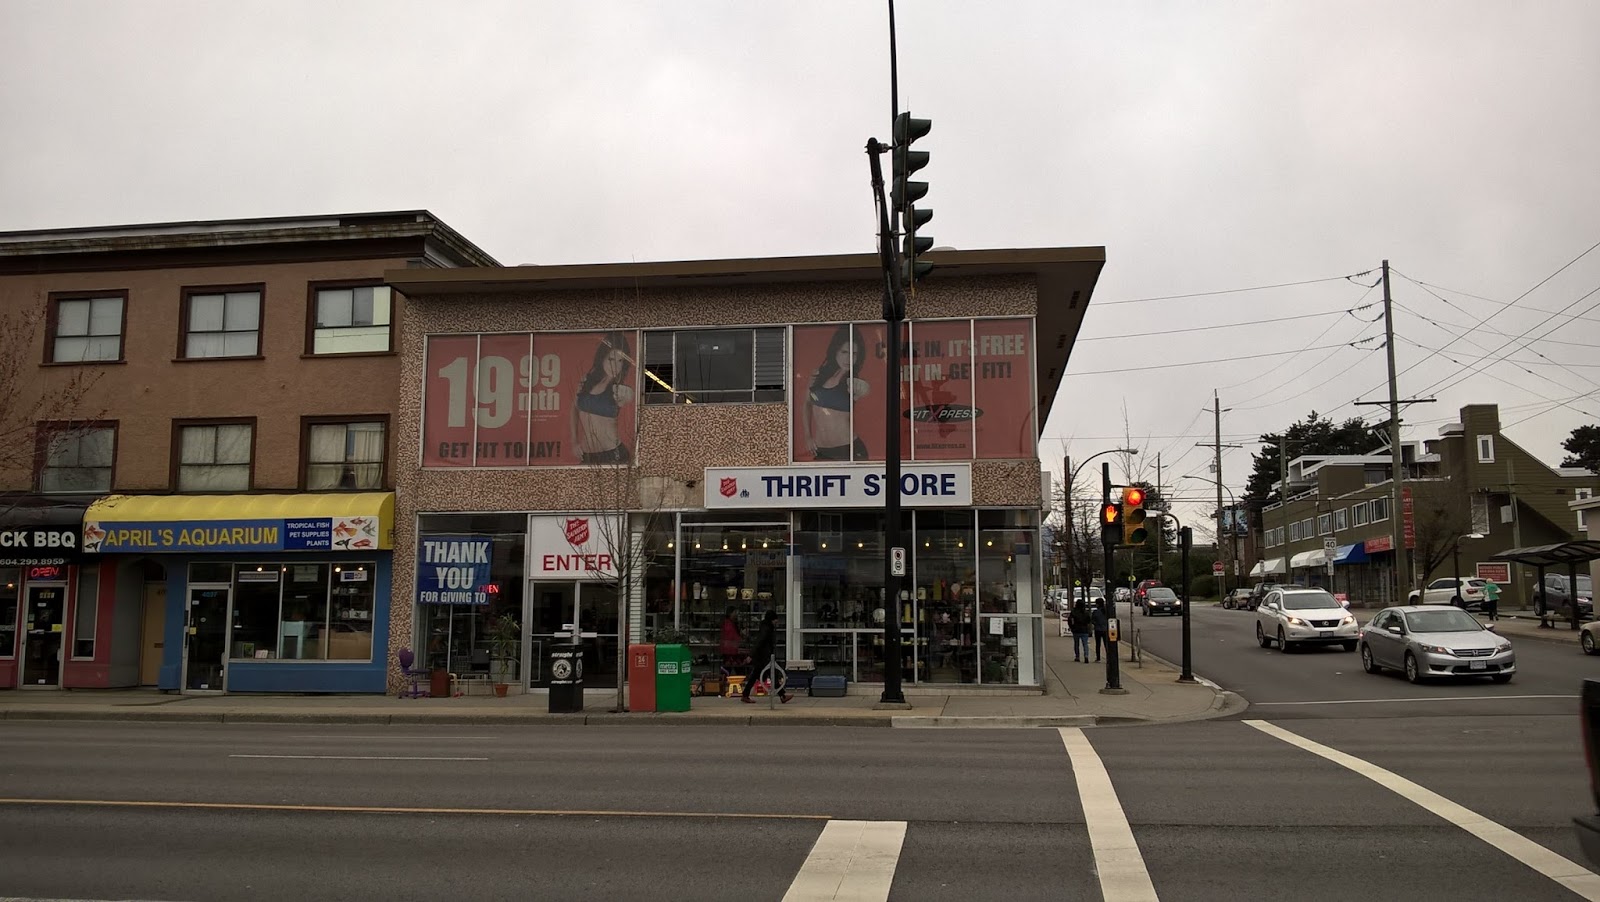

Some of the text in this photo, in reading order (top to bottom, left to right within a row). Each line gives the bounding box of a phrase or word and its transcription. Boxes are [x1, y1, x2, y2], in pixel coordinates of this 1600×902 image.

[876, 341, 919, 359] CME
[948, 339, 978, 357] IT'S
[980, 334, 1025, 356] FREE
[899, 364, 921, 382] ET
[949, 362, 978, 380] GE
[983, 361, 1012, 379] FIT!
[438, 354, 560, 429] 19 99
[518, 388, 560, 411] mth
[439, 442, 469, 458] GET
[504, 441, 561, 458] TODAY!
[761, 475, 851, 497] THRIFT
[863, 473, 956, 496] SORE
[0, 531, 76, 548] CK BBQ
[105, 527, 278, 546] APRIL'S AQUARIUM
[424, 541, 489, 563] THANK
[543, 554, 612, 571] ENTER
[30, 567, 60, 577] OPEN
[436, 567, 475, 590] YOU
[420, 591, 487, 603] FOR GIVING TO
